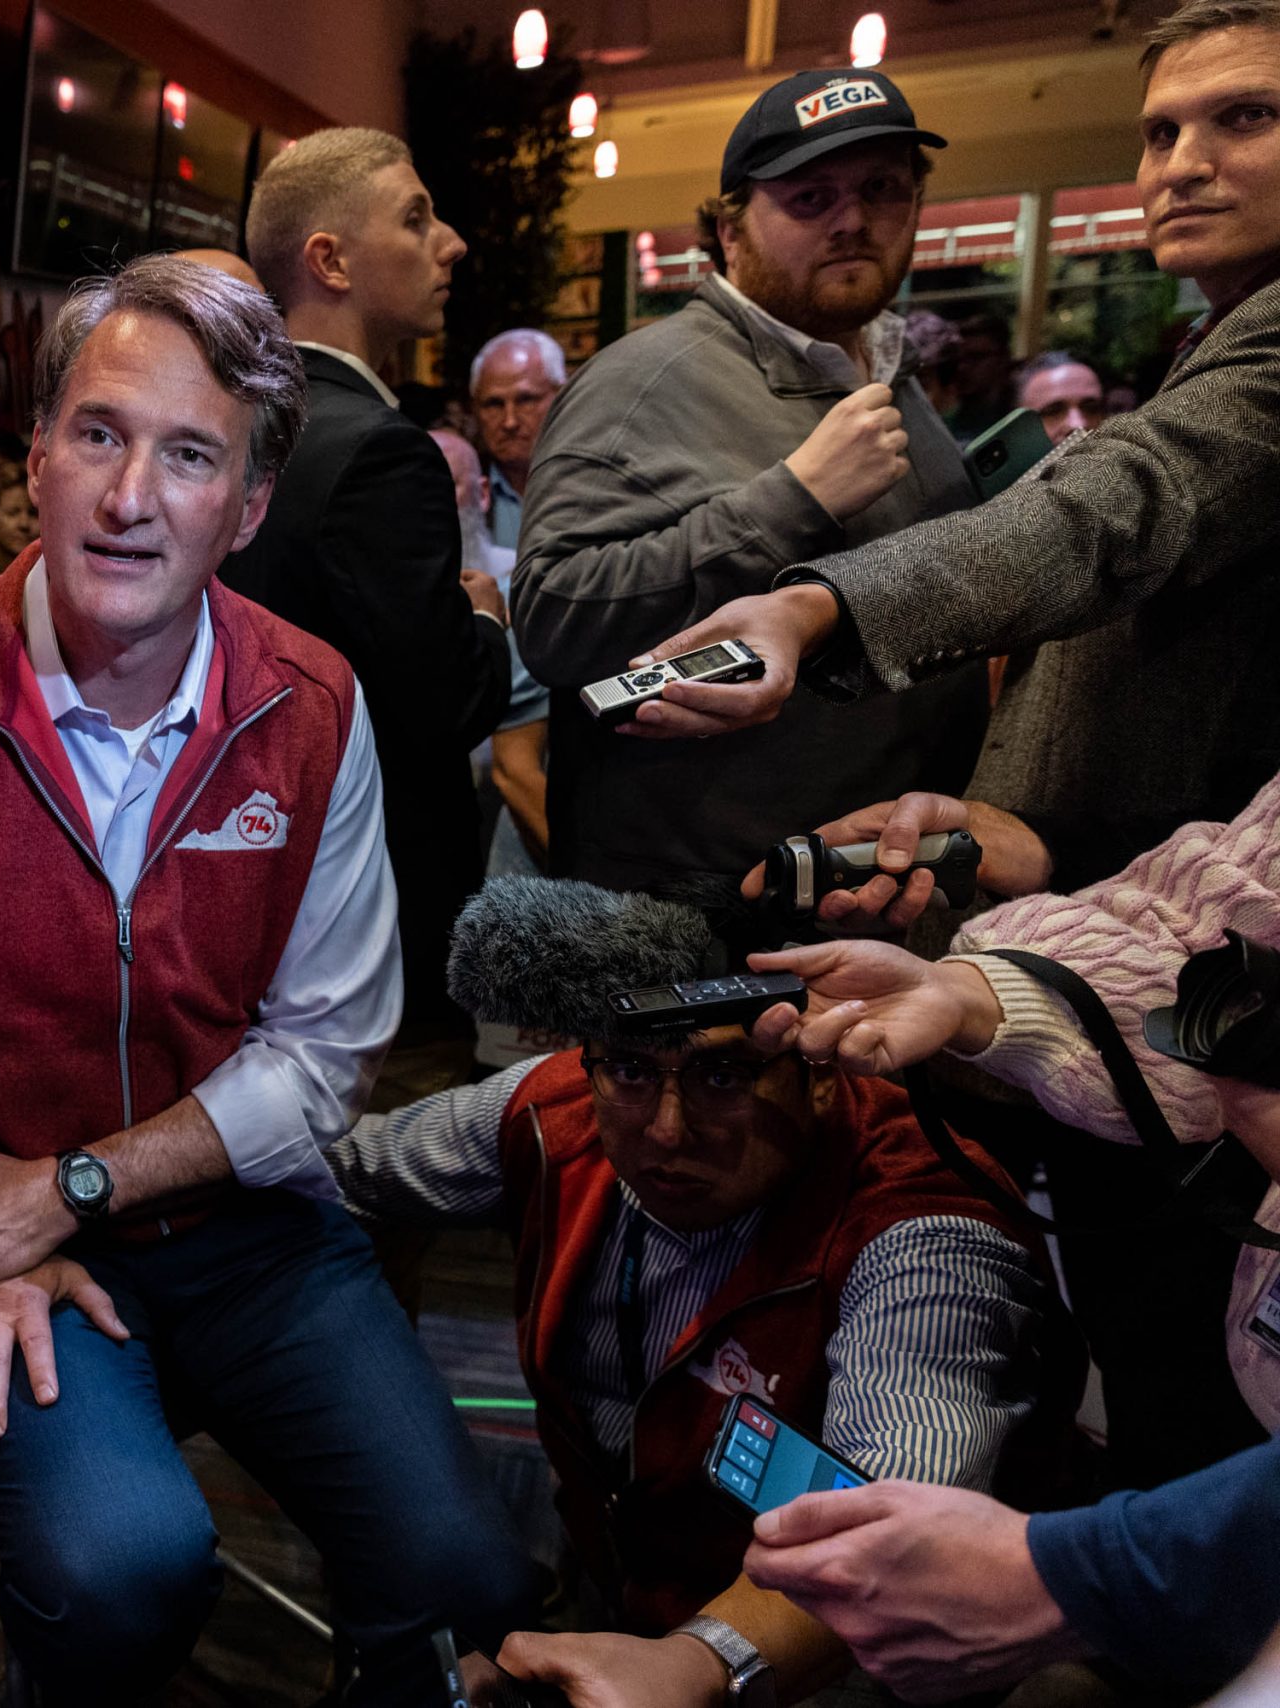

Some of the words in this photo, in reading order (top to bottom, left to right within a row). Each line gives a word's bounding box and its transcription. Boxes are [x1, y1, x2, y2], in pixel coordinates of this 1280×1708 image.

[801, 85, 880, 118] VEGA
[242, 815, 272, 834] 74
[722, 1358, 747, 1385] 74
